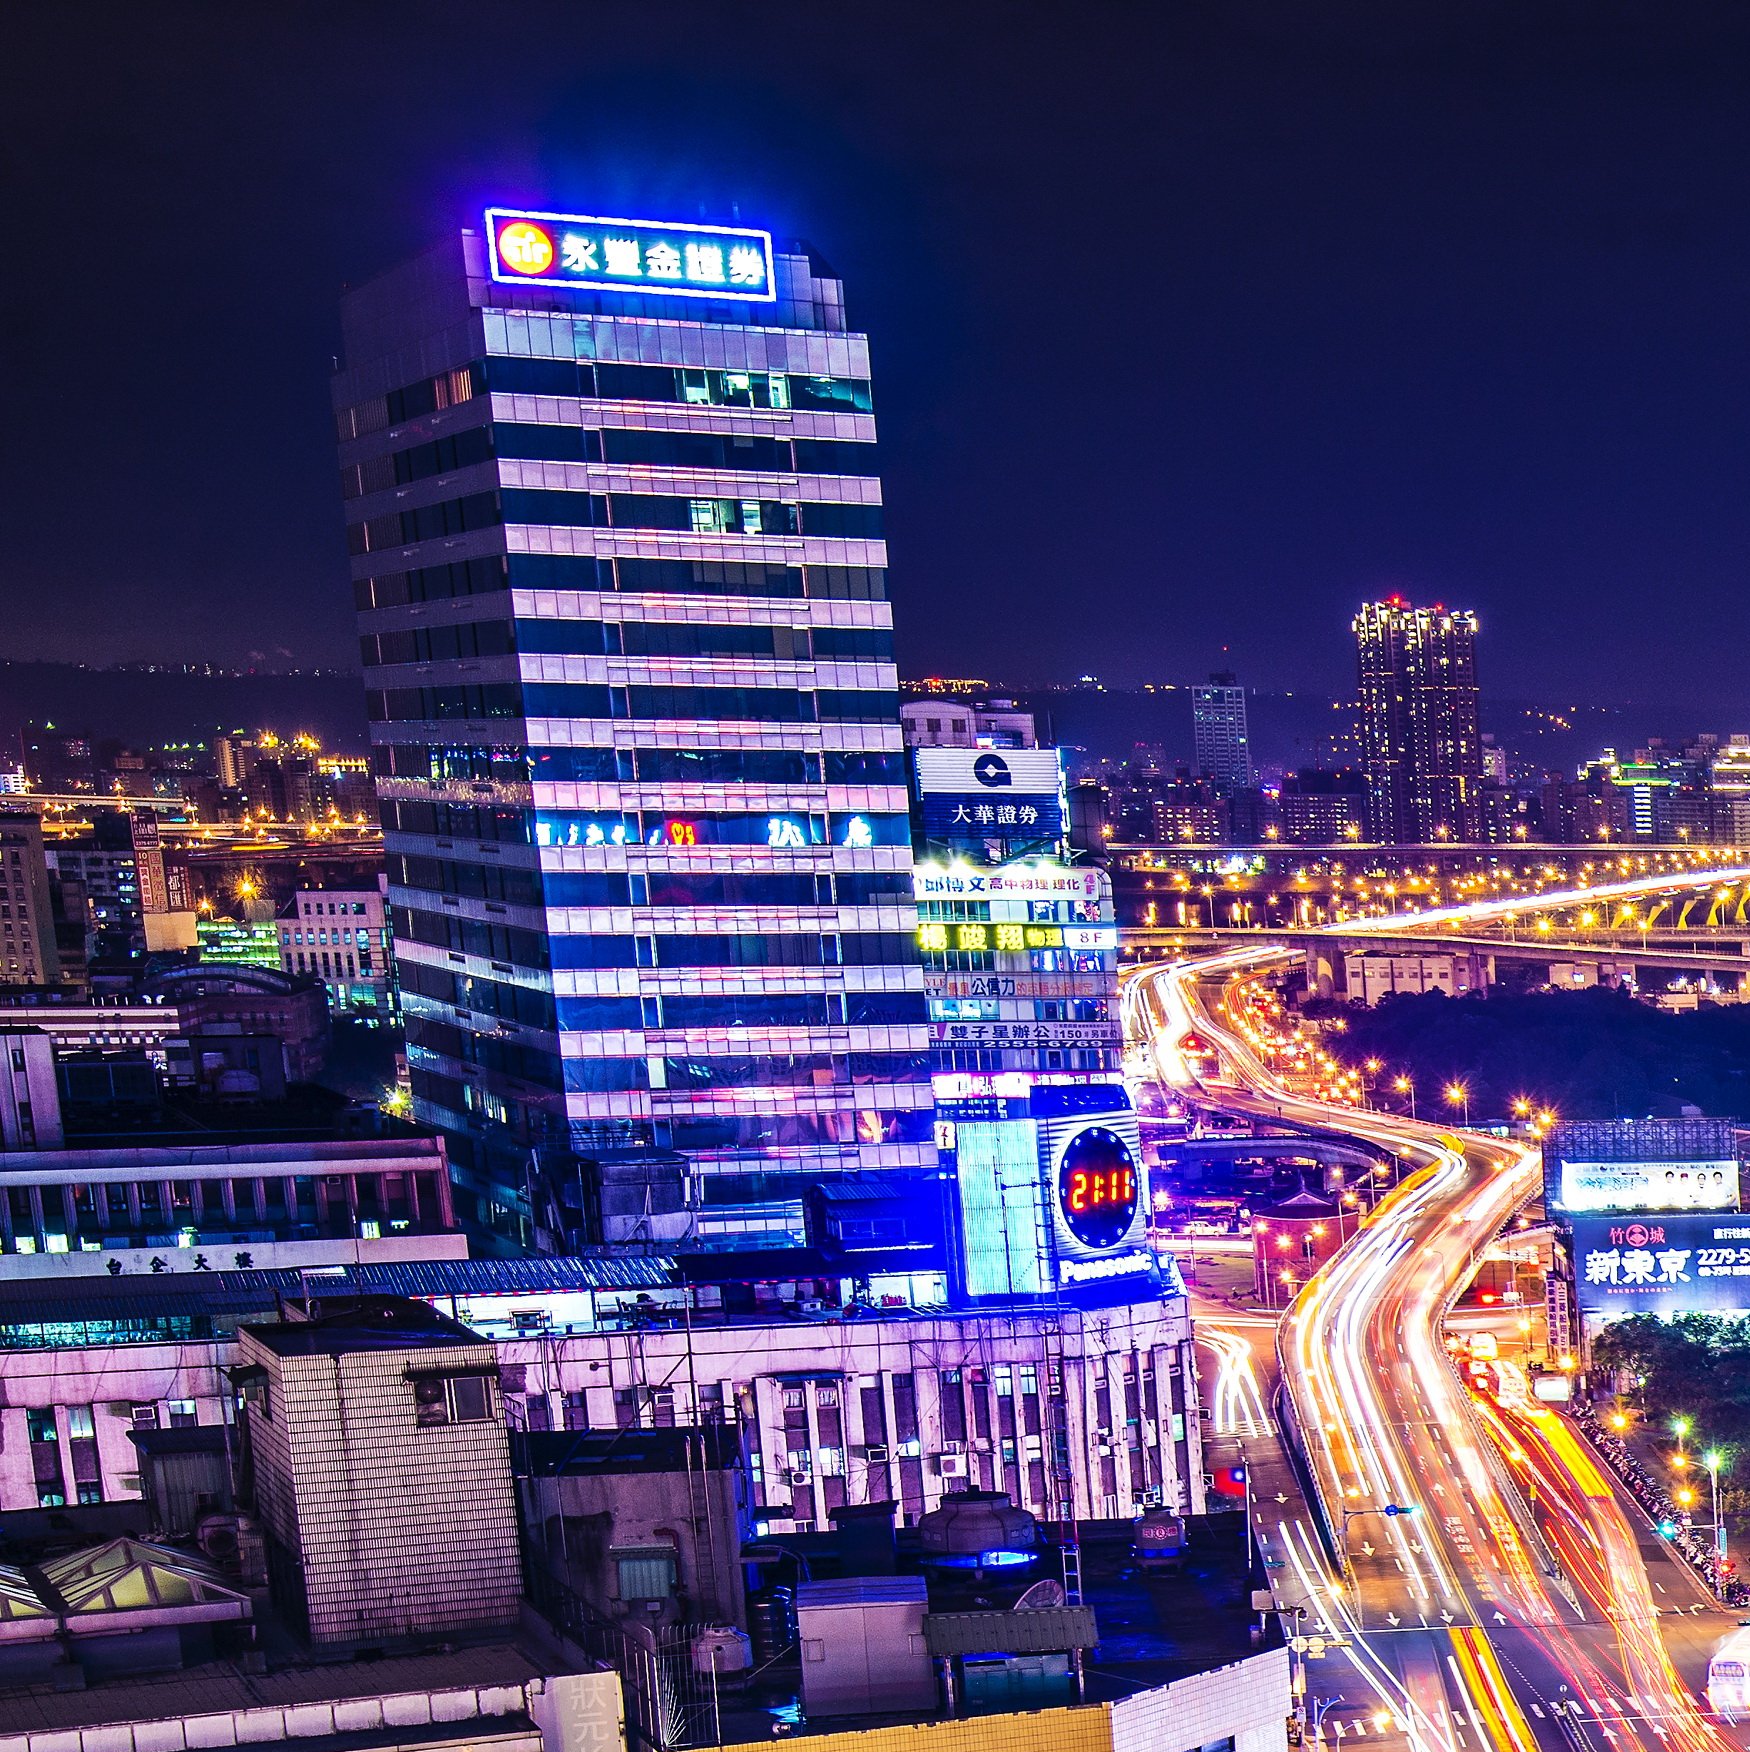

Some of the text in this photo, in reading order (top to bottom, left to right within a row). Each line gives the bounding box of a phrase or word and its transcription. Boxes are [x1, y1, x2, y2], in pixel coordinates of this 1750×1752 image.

[952, 804, 1038, 825] 大華證券
[1072, 1171, 1131, 1210] 21:11
[1059, 1249, 1153, 1284] Panasonic
[1584, 1248, 1693, 1286] 新東京
